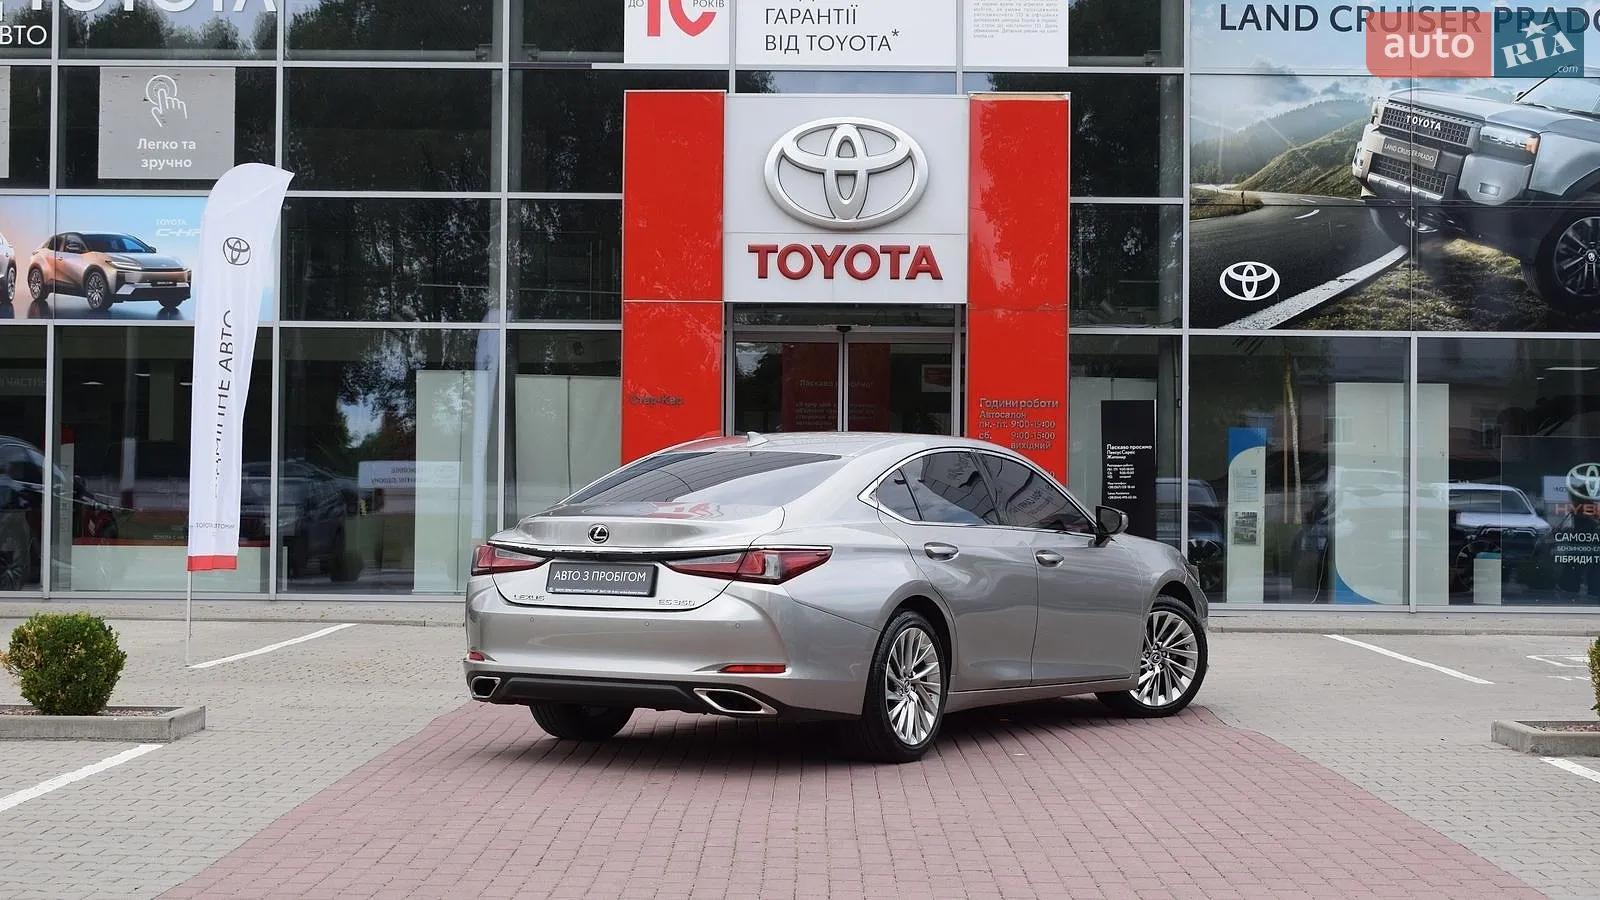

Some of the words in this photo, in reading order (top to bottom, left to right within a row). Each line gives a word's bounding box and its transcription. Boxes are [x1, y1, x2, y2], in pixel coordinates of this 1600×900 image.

[765, 4, 858, 25] ГАРАНТІЇ
[1220, 4, 1319, 32] LAND
[1330, 5, 1482, 34] CRUISER
[765, 35, 800, 54] ВІД
[1406, 115, 1441, 131] TOYOTA
[137, 138, 178, 150] Легко
[182, 140, 196, 150] та
[141, 158, 192, 170] зручно
[748, 243, 943, 281] TOYOTA
[980, 398, 1018, 409] Години
[1020, 398, 1059, 409] роботи
[980, 410, 1027, 419] Автосалон
[1554, 555, 1593, 564] ГІБРИДИ
[554, 570, 581, 582] АВТО
[591, 571, 647, 583] ПРОБІГОМ
